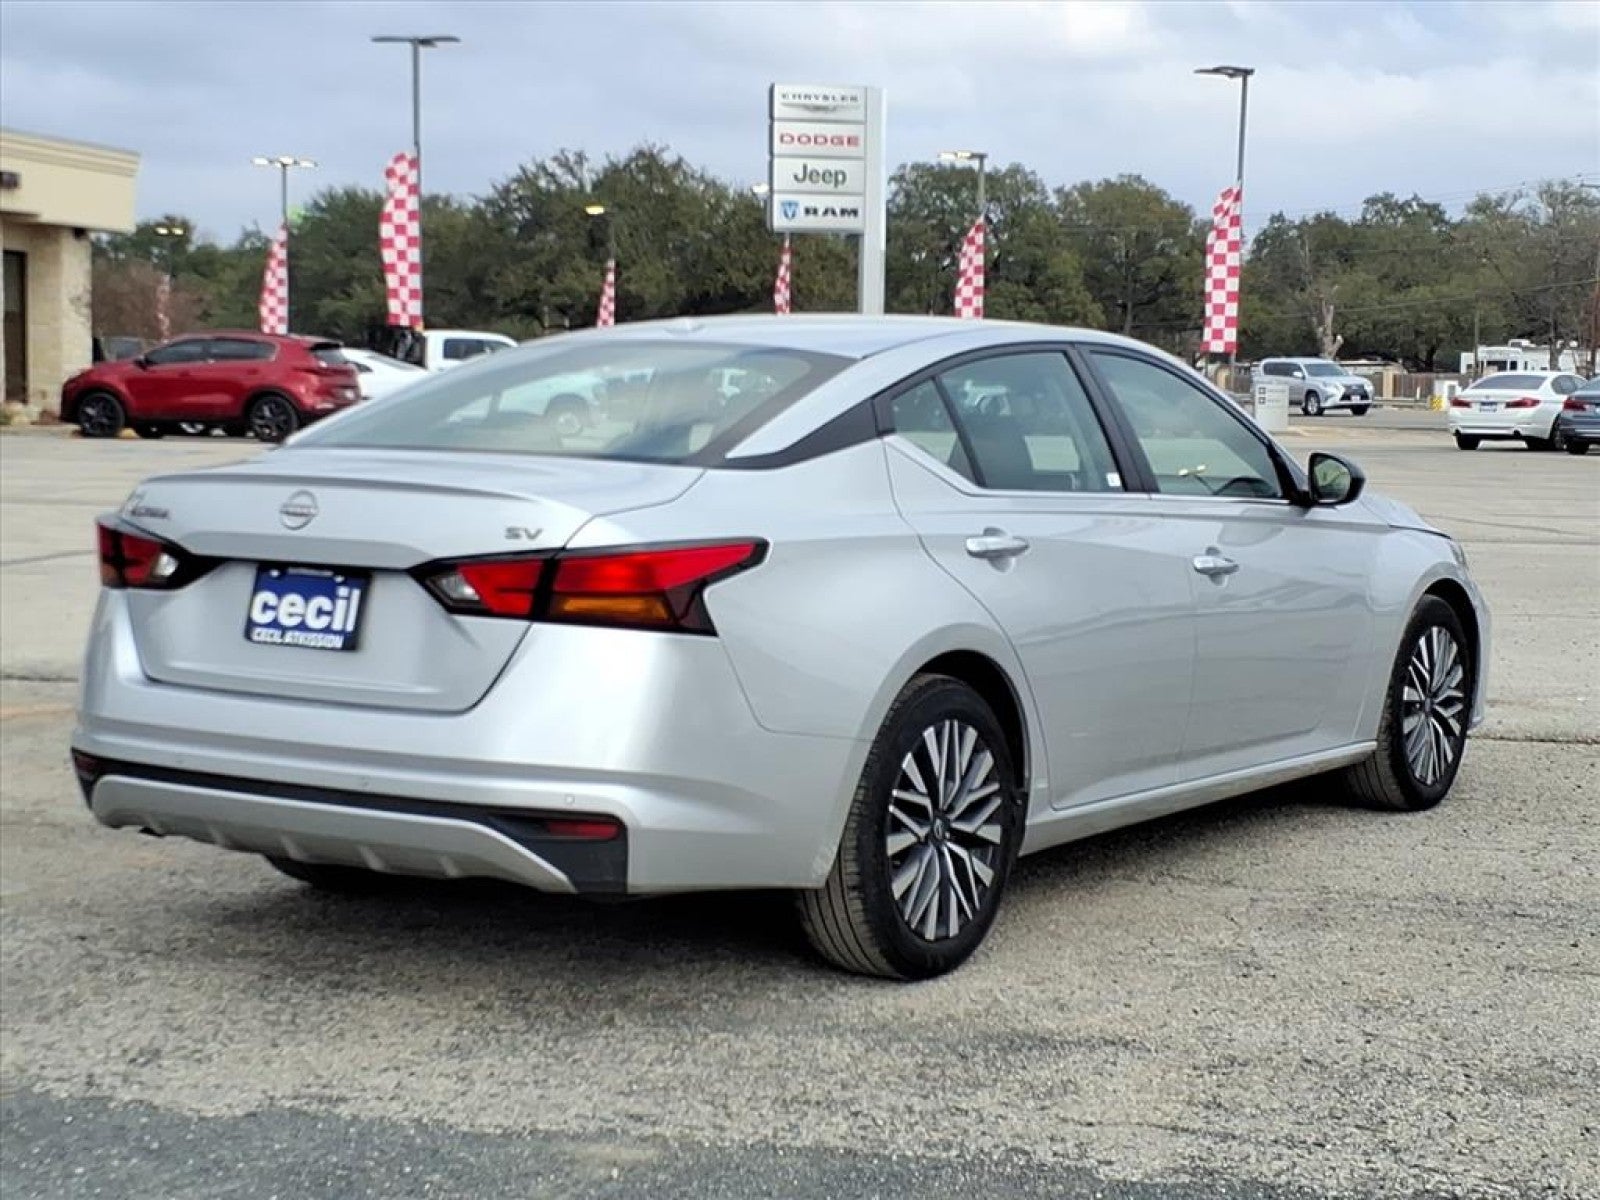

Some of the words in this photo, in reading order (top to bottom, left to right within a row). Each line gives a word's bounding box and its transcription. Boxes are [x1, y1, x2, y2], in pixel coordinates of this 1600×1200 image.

[780, 133, 860, 147] DODGE
[793, 163, 847, 188] Jeep
[804, 206, 859, 218] RAM
[505, 526, 543, 540] SV
[251, 586, 361, 632] cecil
